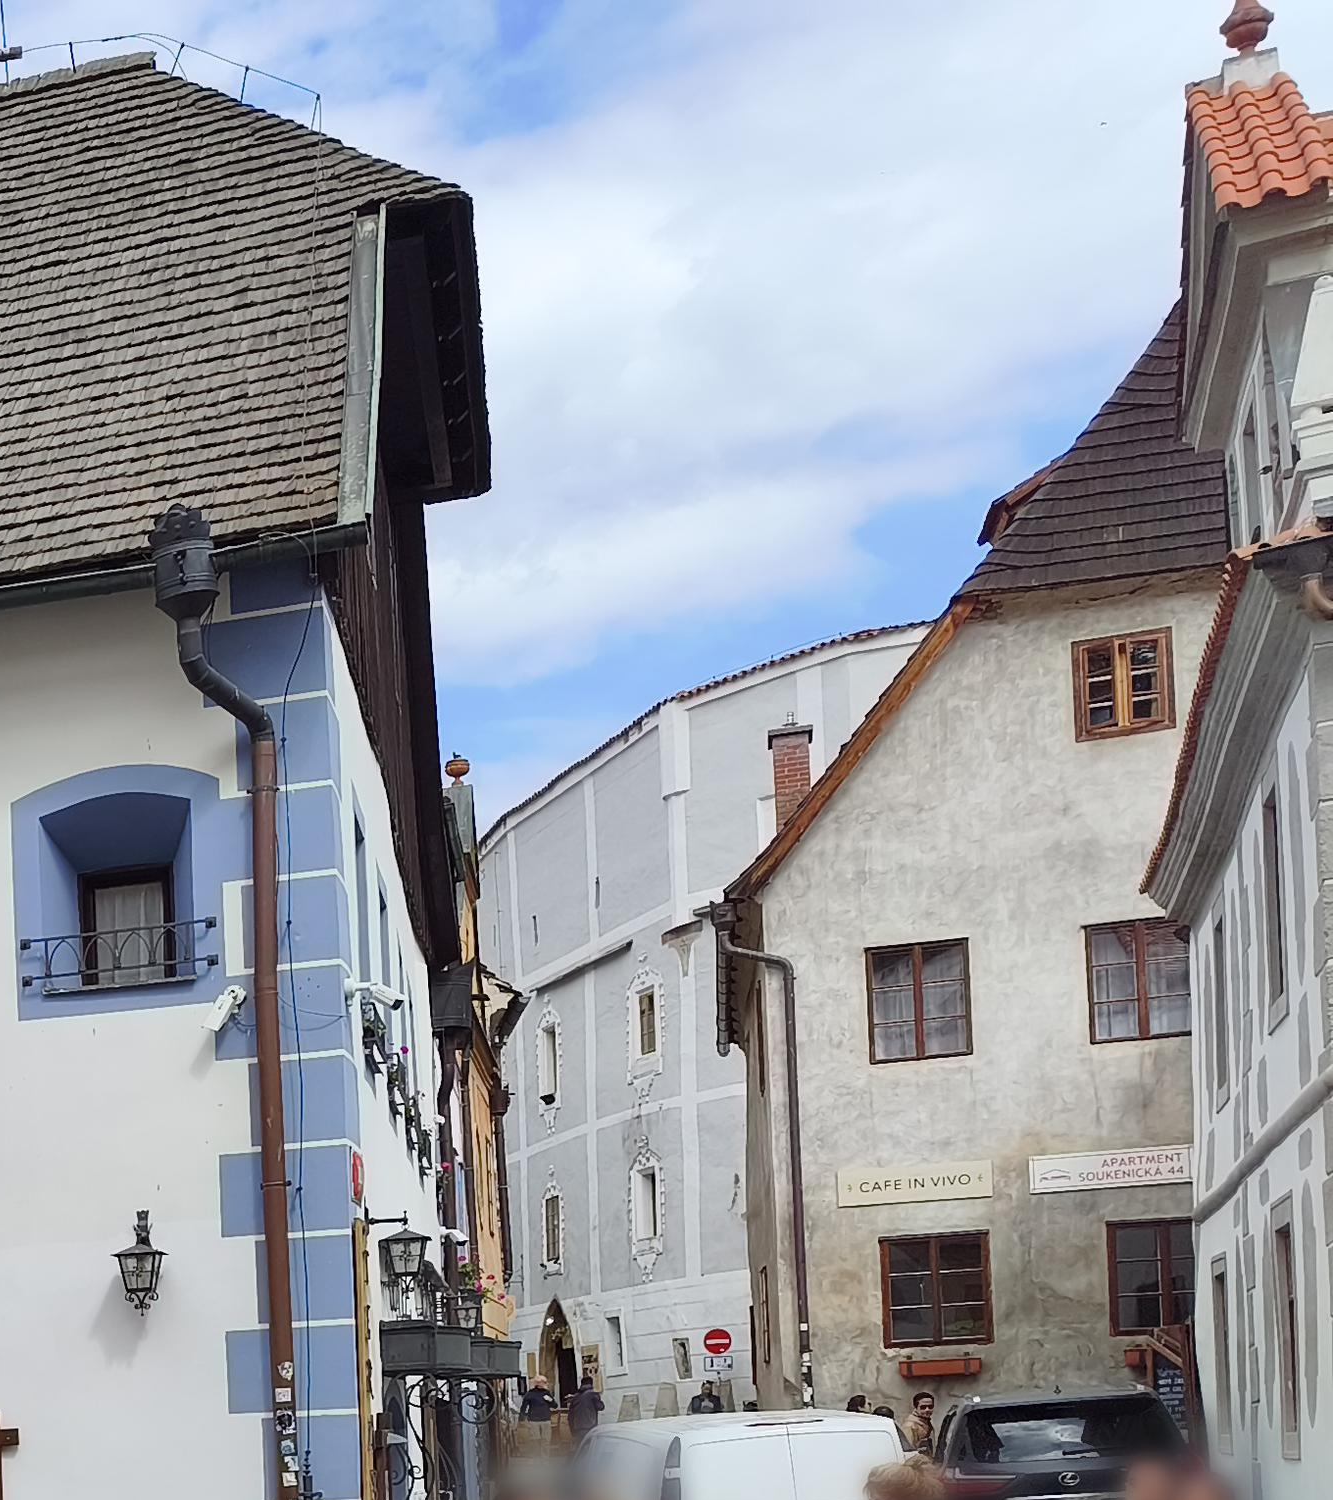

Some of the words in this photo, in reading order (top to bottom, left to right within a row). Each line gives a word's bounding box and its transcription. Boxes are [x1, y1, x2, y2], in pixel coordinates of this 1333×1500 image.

[1102, 1153, 1183, 1168] APARTMENT
[1168, 1165, 1184, 1175] 44
[859, 1179, 902, 1193] CAFE
[908, 1178, 925, 1189] IN
[931, 1174, 971, 1187] VIVO
